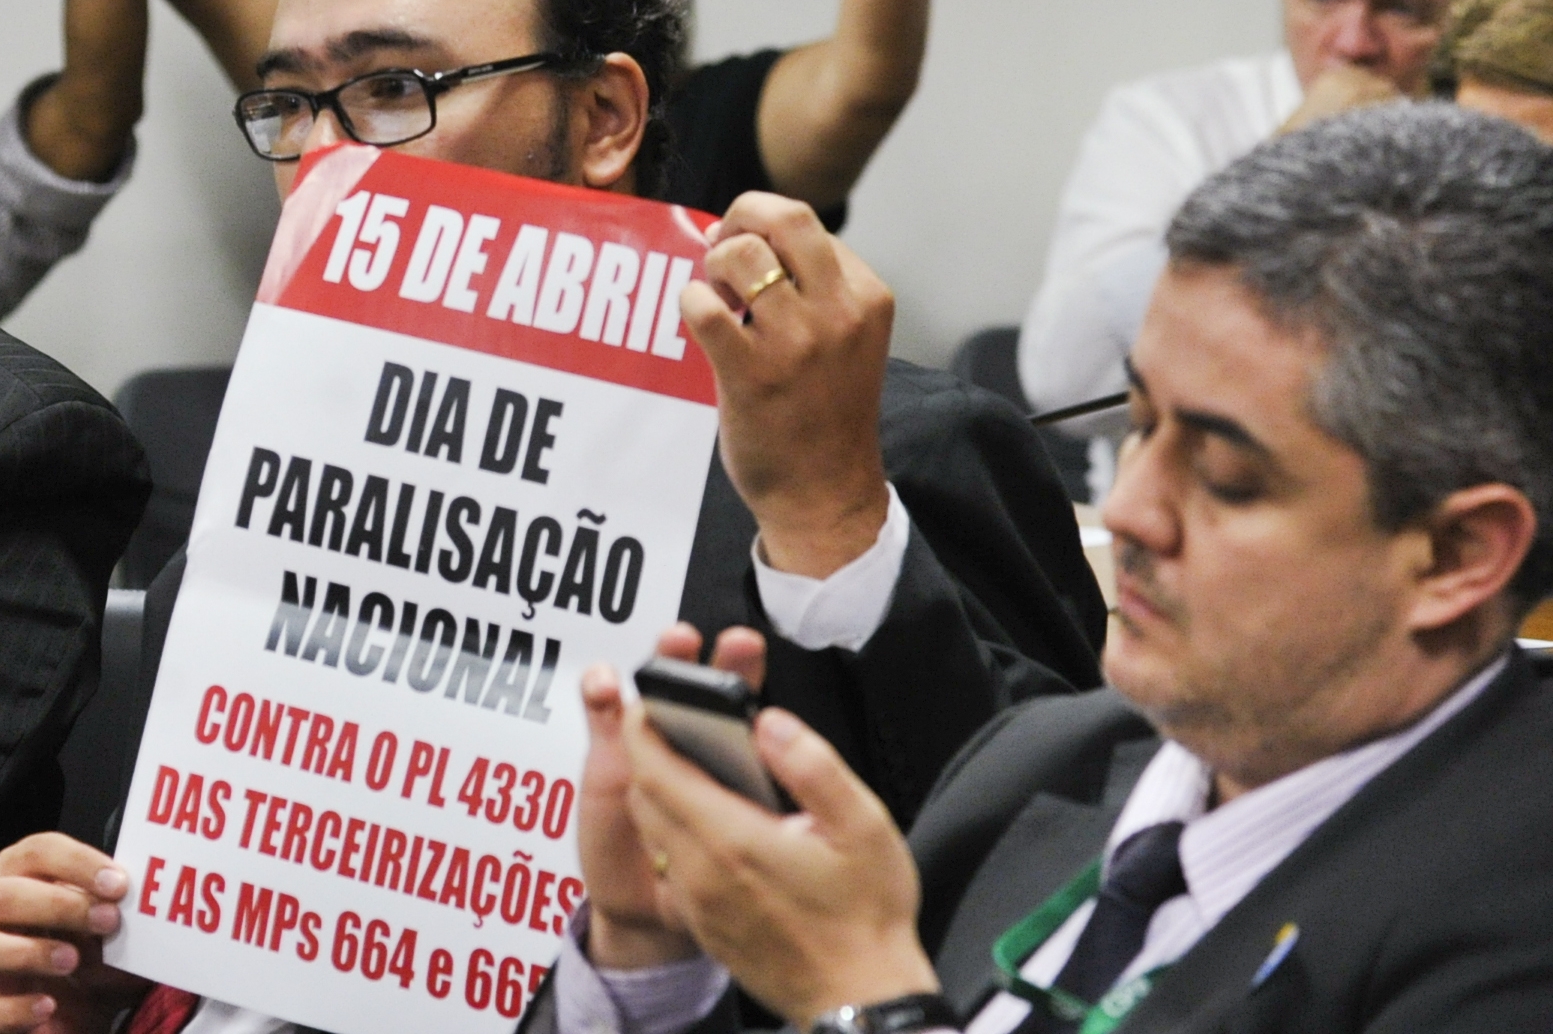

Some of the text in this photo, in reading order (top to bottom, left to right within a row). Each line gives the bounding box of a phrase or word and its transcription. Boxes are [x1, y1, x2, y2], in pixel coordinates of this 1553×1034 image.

[322, 189, 694, 361] 15 DE ABRIL
[363, 360, 565, 486] DIA DE
[235, 446, 644, 625] PARALISAÇÃO
[264, 569, 562, 725] NACIONAL
[194, 684, 575, 840] CONTRA O PL 4330
[138, 856, 166, 917] E
[166, 866, 226, 934] AS
[231, 881, 322, 963] MPs
[331, 910, 419, 990] 664
[426, 946, 454, 1000] e
[146, 764, 584, 938] DAS TERCEIRIZAÇÕES
